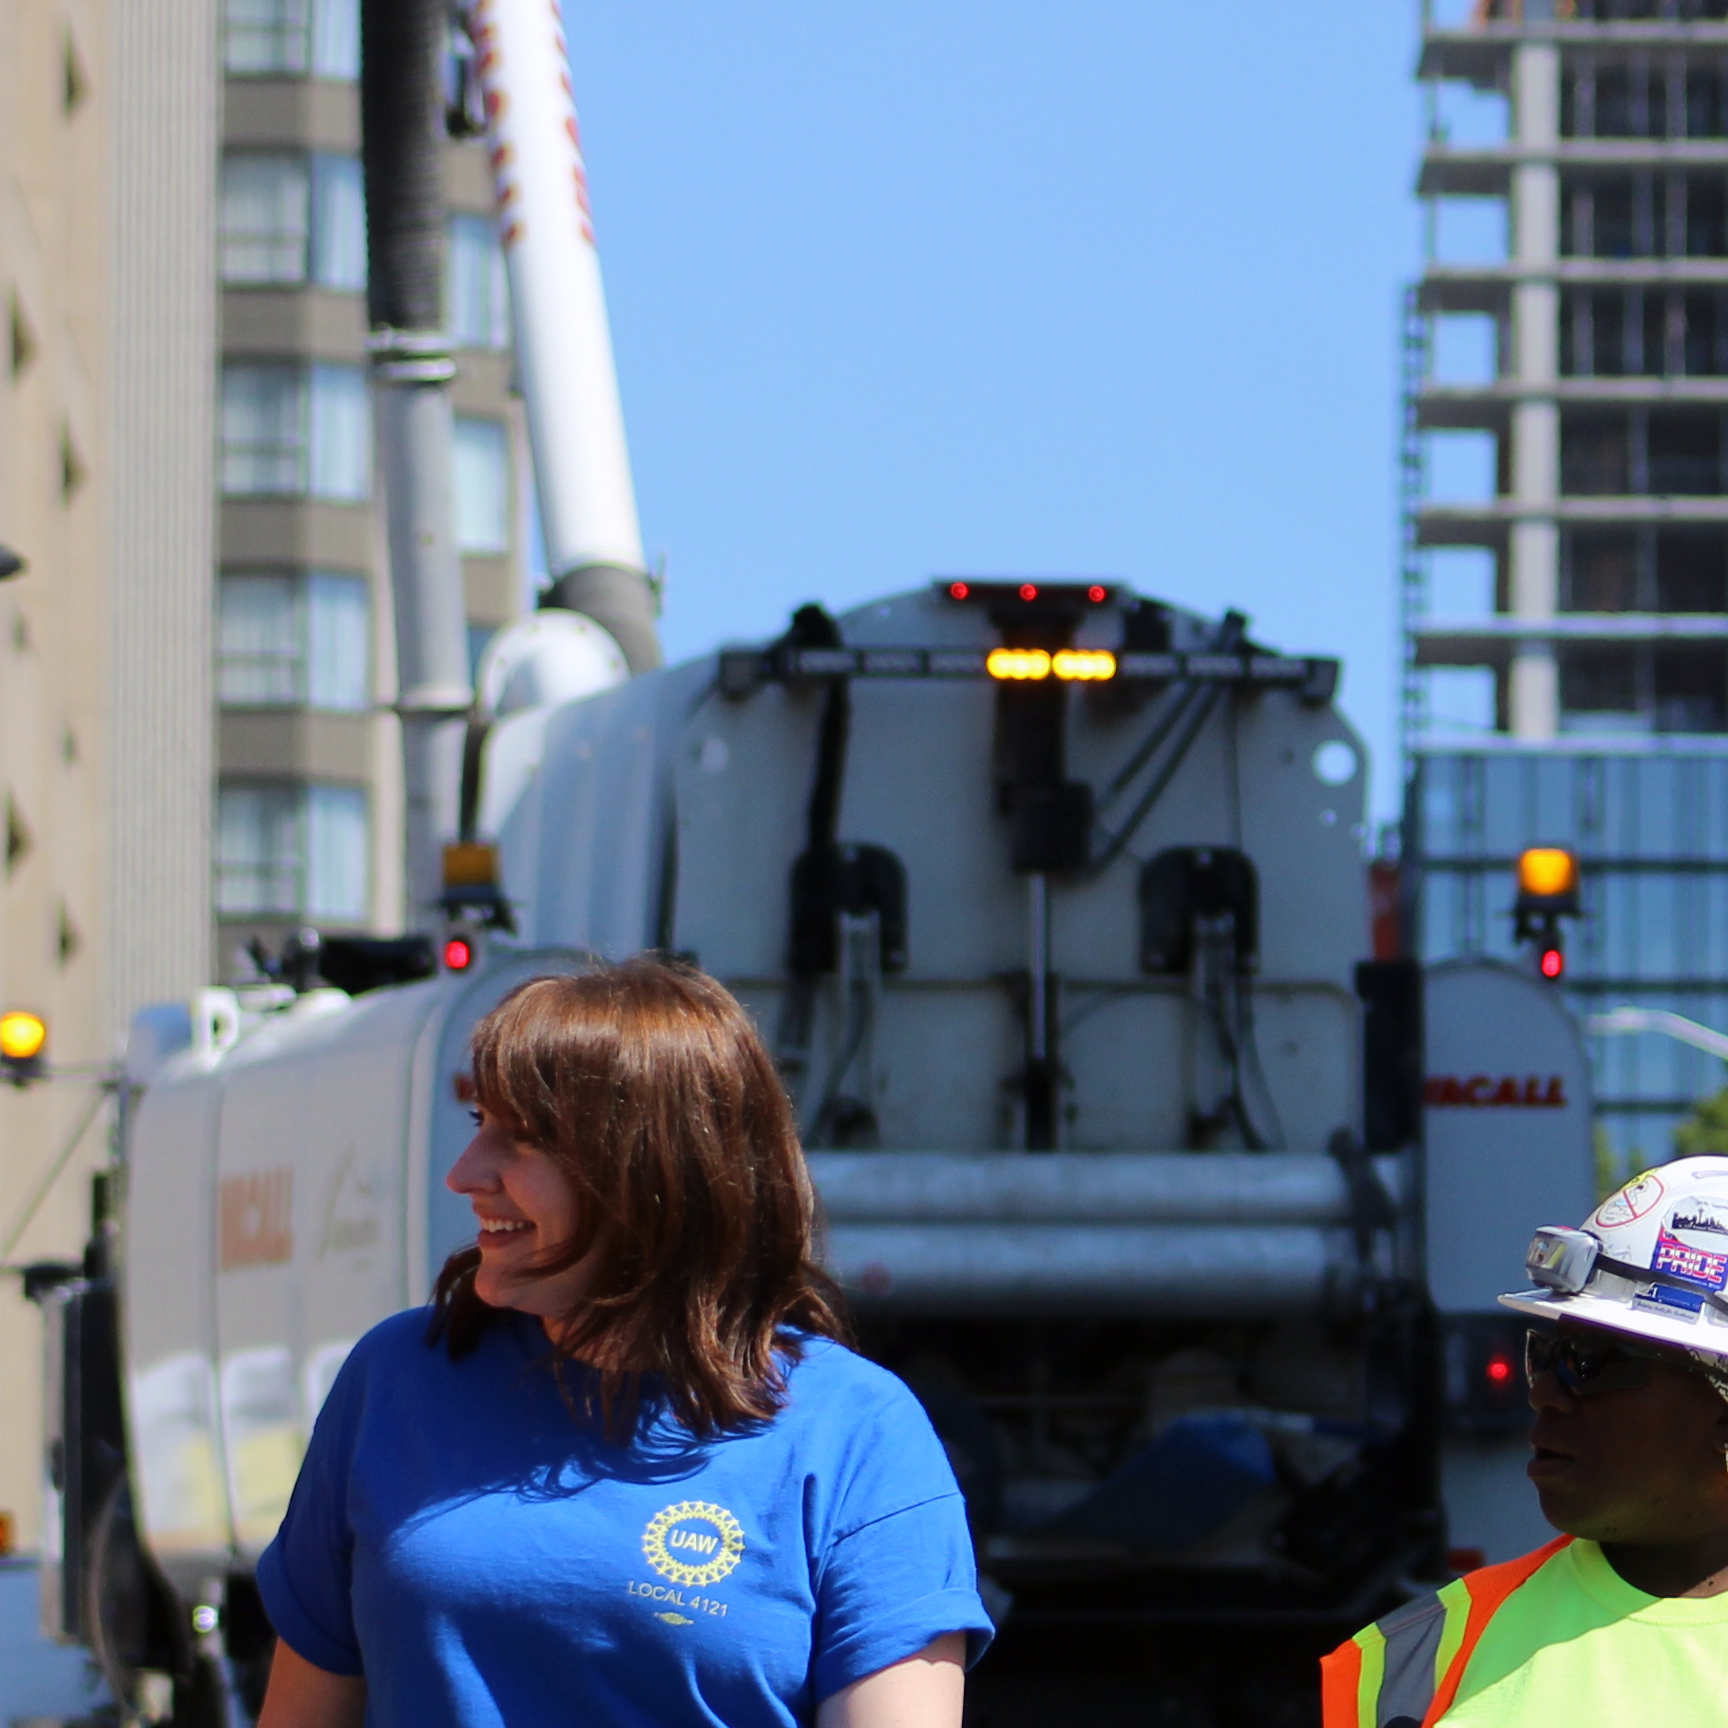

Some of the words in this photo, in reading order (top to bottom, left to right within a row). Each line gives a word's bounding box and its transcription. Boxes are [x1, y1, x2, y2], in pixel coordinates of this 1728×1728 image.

[1655, 1242, 1728, 1284] PRIDE
[670, 1529, 719, 1555] UAW
[627, 1580, 686, 1606] LOCAL
[689, 1595, 729, 1617] 4121
